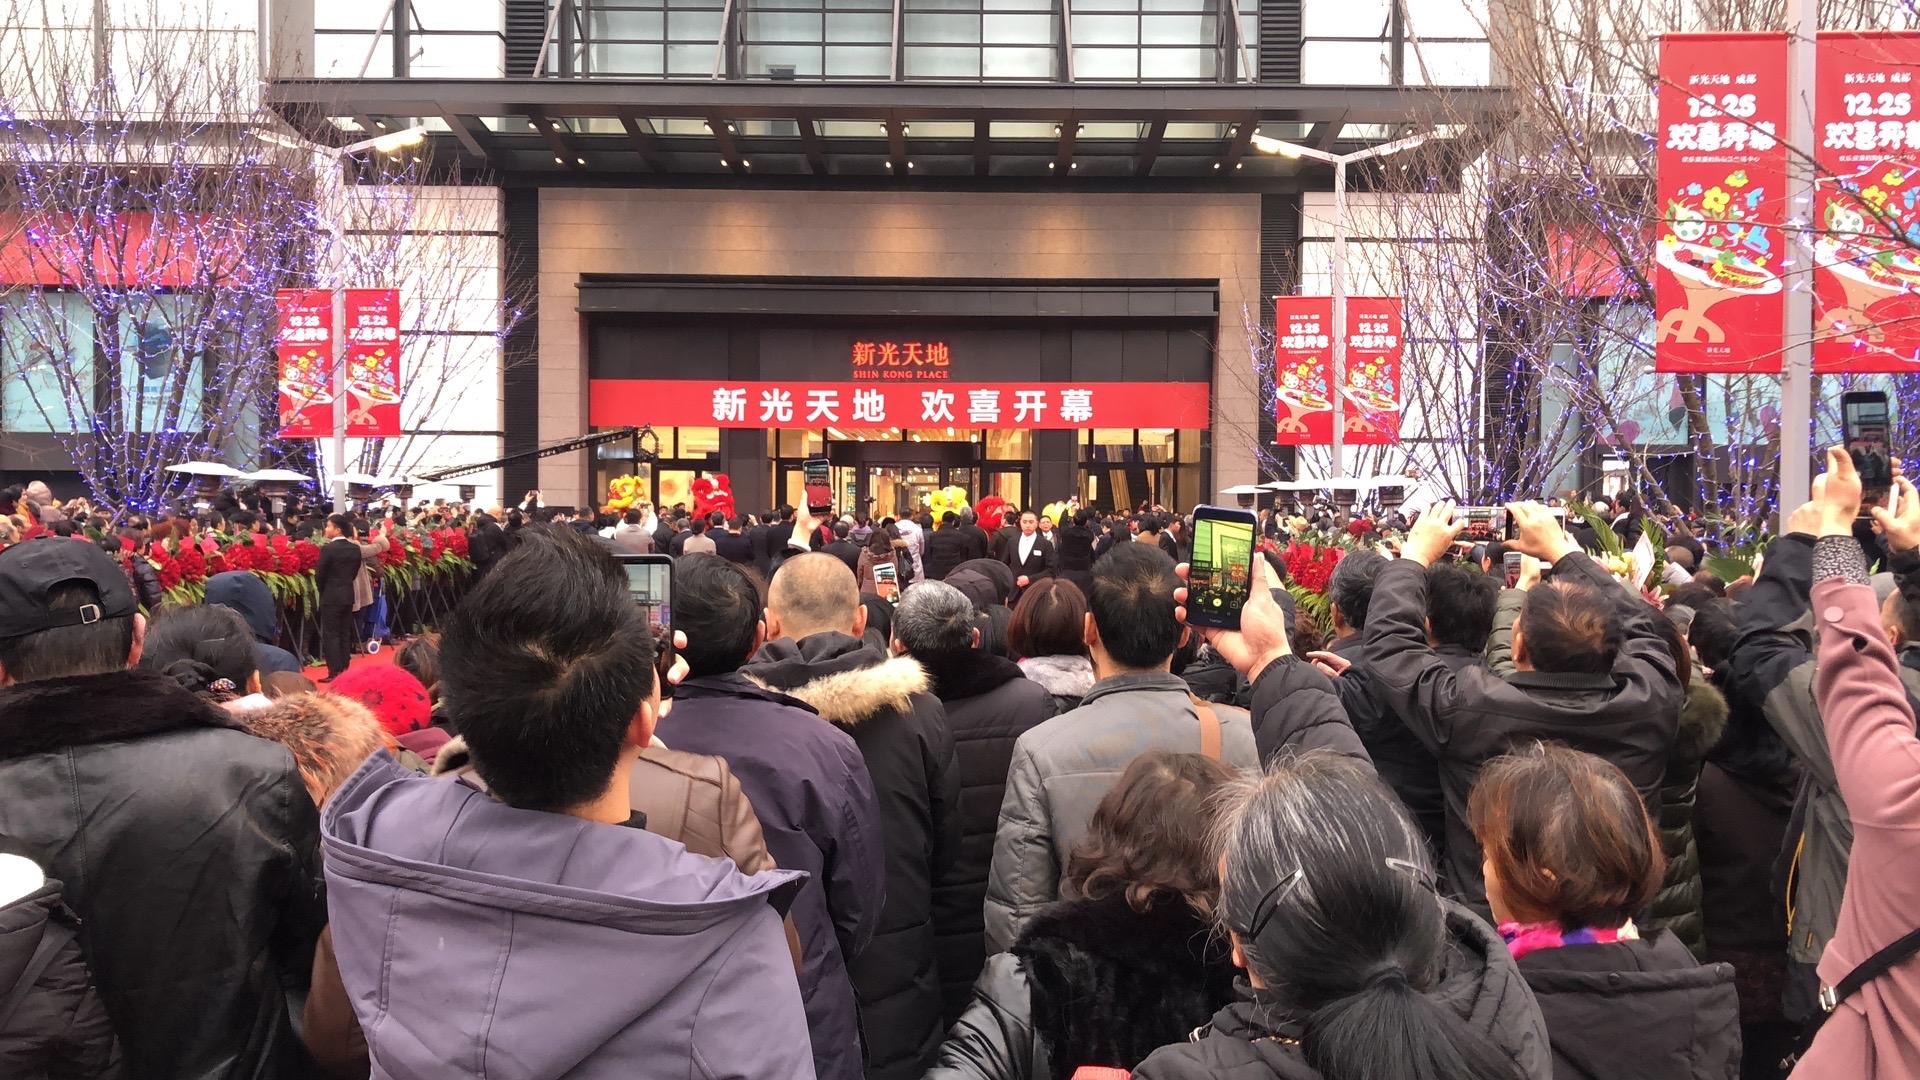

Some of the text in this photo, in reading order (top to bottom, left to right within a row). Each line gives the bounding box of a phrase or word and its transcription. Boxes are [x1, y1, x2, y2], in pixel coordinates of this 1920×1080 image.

[1687, 93, 1757, 118] 12.25
[1844, 92, 1911, 117] 12.25
[1665, 120, 1777, 151] 欢喜开幕
[1289, 322, 1320, 334] 12.25
[1358, 322, 1389, 334] 12.25
[852, 342, 949, 366] 新光天地
[853, 370, 948, 379] SHIN KONG PLACE
[712, 387, 1093, 422] 新光天地 欢喜开幕
